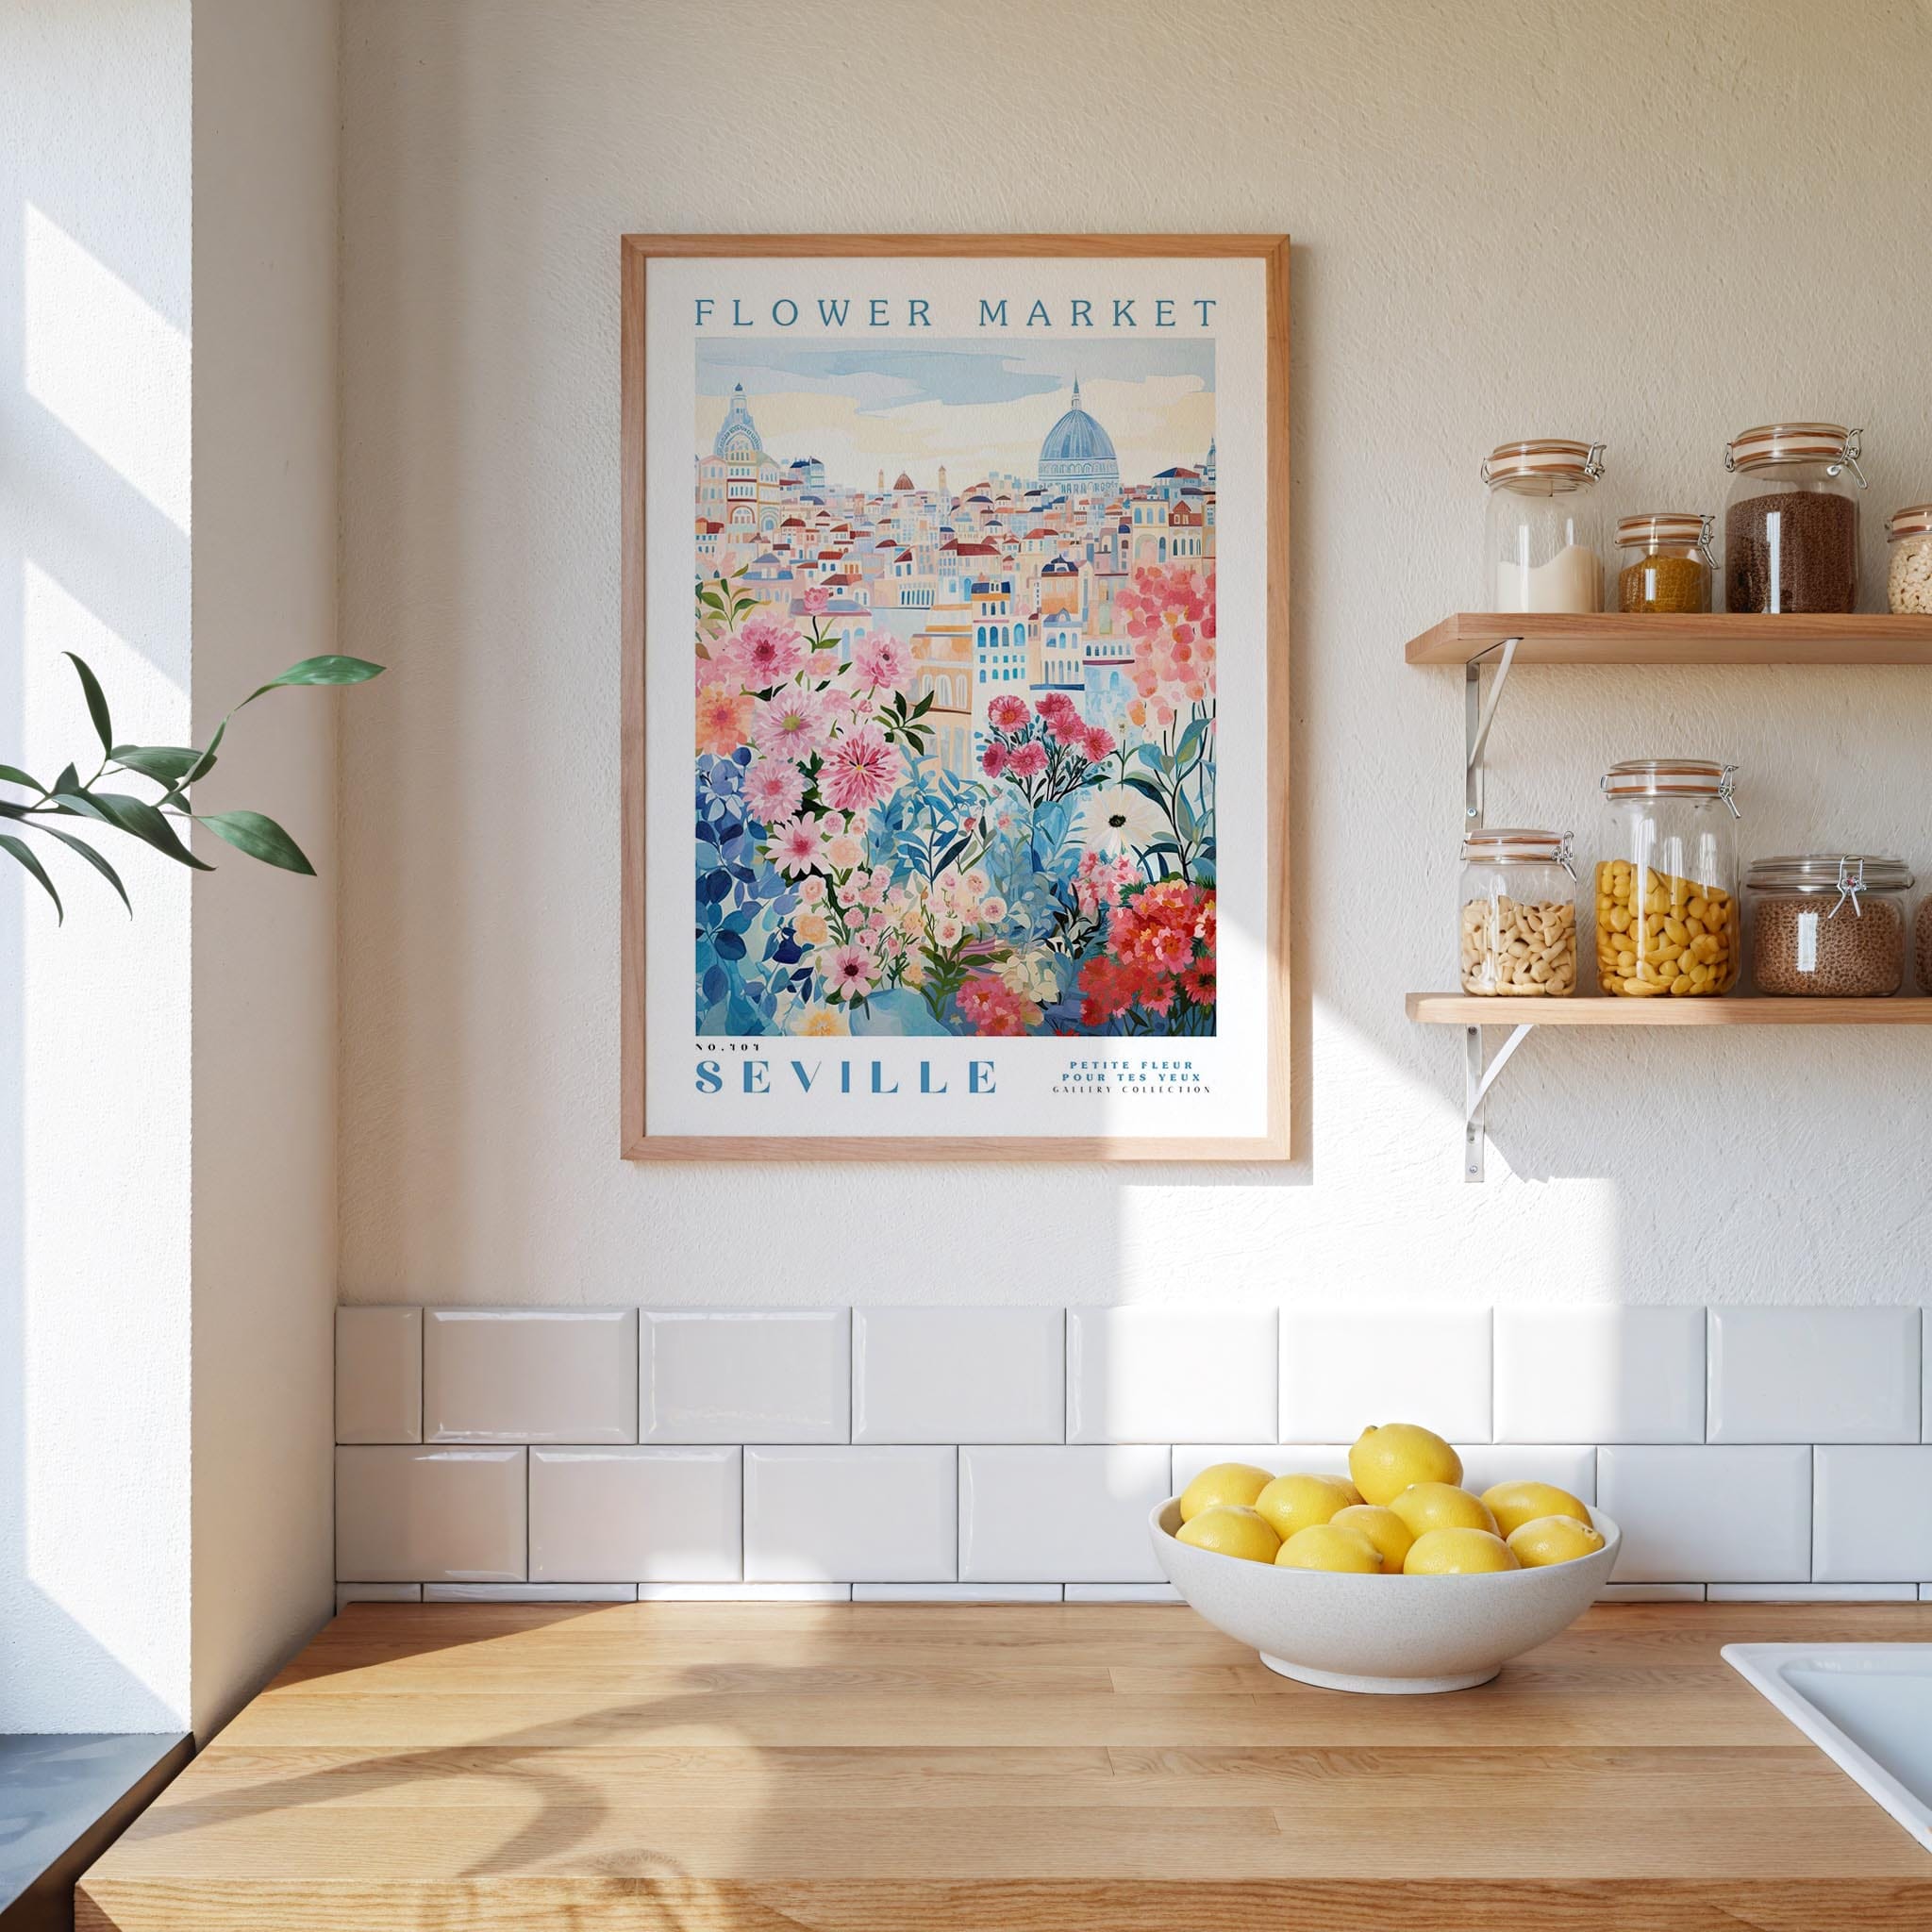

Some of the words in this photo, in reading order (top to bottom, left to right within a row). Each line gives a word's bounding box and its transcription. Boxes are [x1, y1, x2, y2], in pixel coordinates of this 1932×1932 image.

[694, 298, 931, 327] FLOWER
[979, 298, 1217, 327] MARKET
[1069, 1060, 1130, 1071] PETITE
[1141, 1060, 1192, 1071] FLEUR
[695, 1060, 997, 1094] SEVILLE
[1062, 1073, 1107, 1083] POUR
[1116, 1073, 1147, 1083] TES
[1158, 1073, 1201, 1083] YEUX
[1052, 1086, 1111, 1094] GALLERY
[1122, 1086, 1210, 1094] COLLECTION
